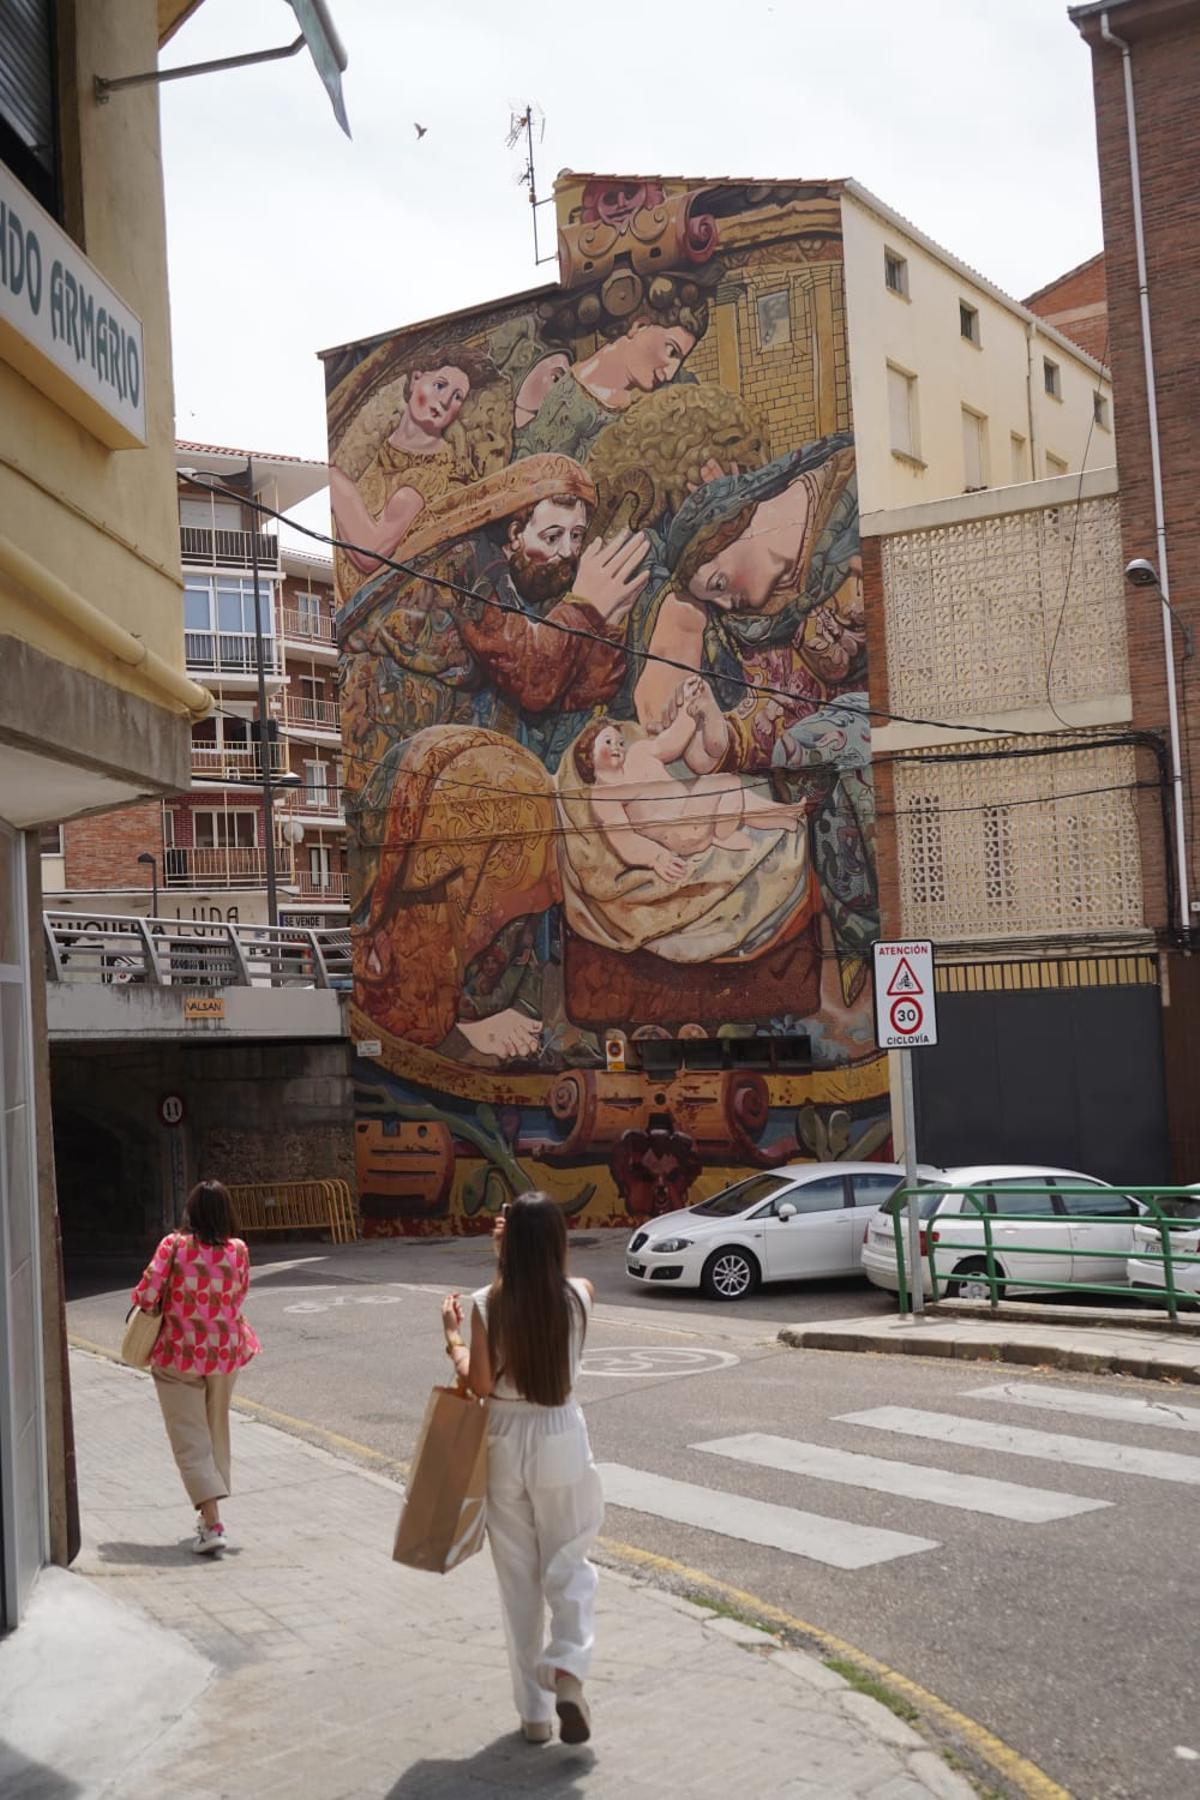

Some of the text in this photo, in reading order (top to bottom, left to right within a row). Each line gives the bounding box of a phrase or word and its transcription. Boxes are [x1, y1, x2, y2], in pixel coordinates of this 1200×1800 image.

[50, 259, 139, 409] ARMARIO
[176, 906, 239, 937] LUNA
[285, 916, 320, 927] SE VENDE
[879, 945, 928, 956] ATENCIÓN
[897, 1009, 916, 1022] 30
[886, 1034, 930, 1046] CICLOVÍA
